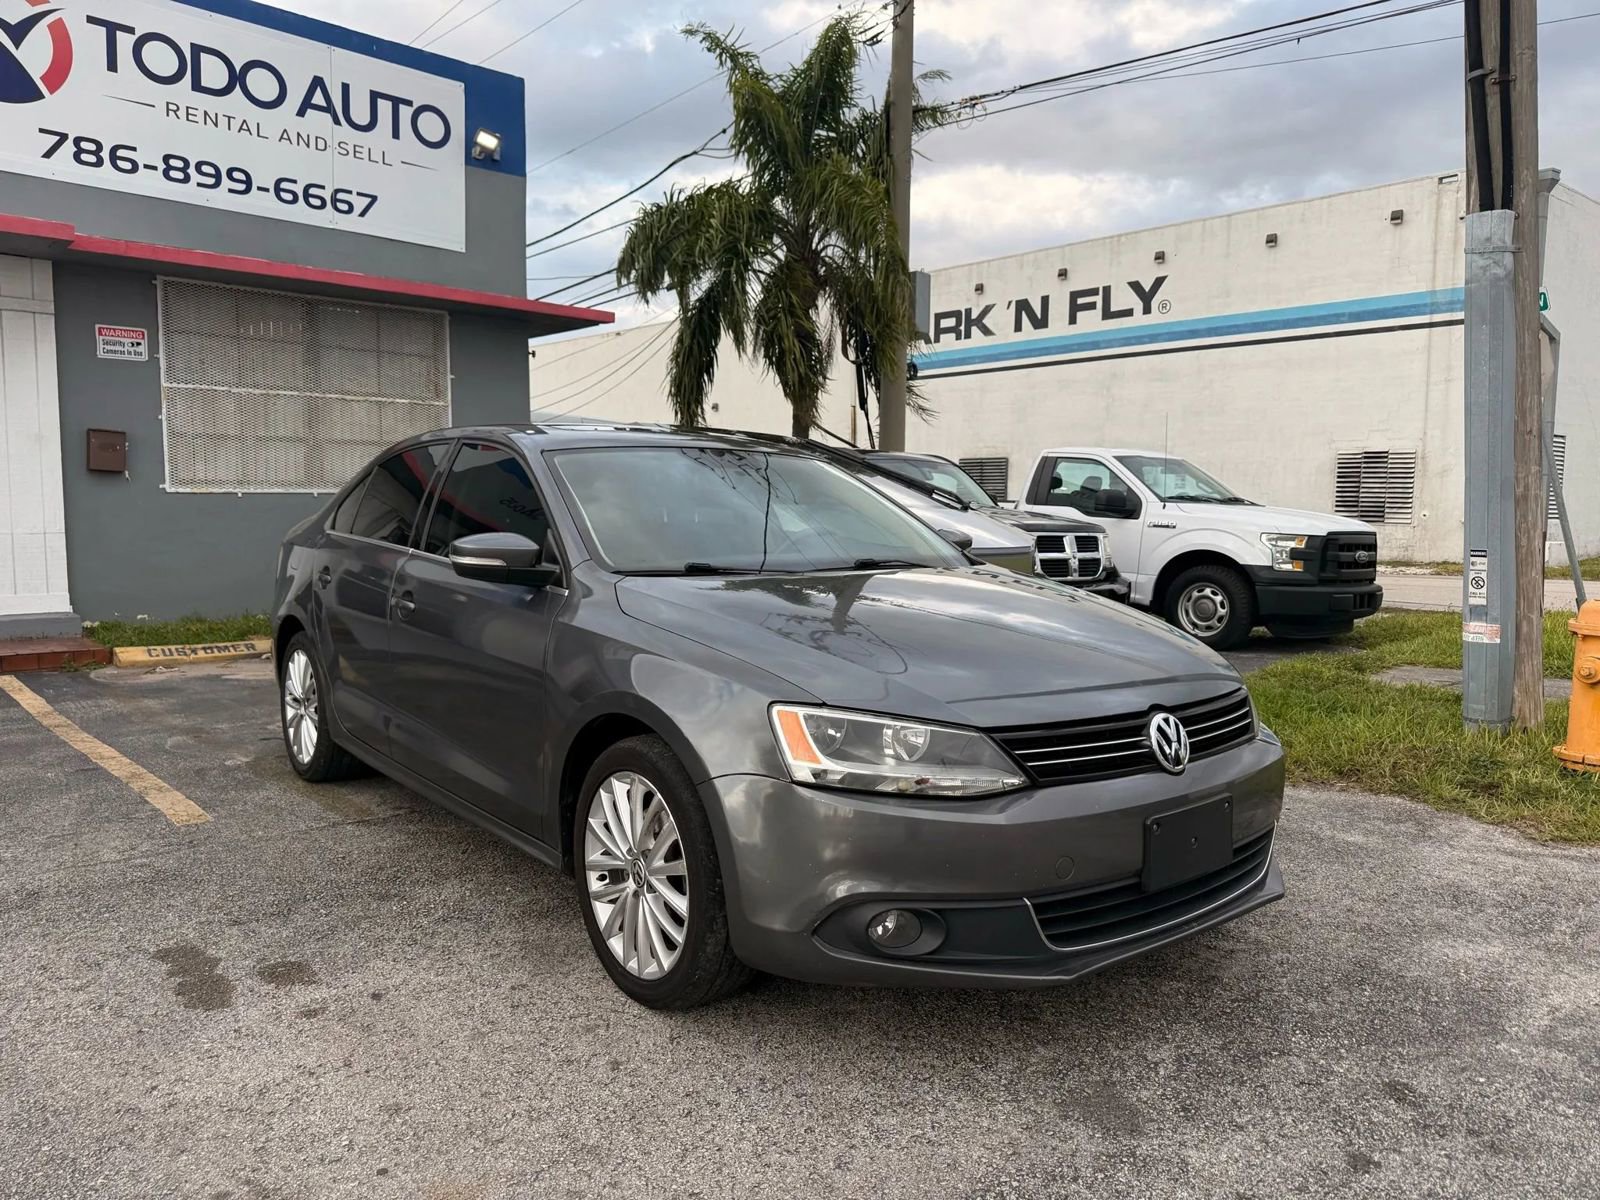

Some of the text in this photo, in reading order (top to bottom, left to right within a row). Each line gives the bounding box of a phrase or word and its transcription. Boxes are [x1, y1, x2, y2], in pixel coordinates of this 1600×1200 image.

[86, 15, 451, 149] TODO AUTO
[165, 101, 393, 166] RENTAL AND SELL
[38, 127, 378, 218] 786-899-6667
[914, 303, 997, 344] RK
[1068, 275, 1169, 325] FLY
[100, 328, 143, 339] WARNING
[102, 339, 125, 348] Security
[102, 347, 126, 355] Cameras
[147, 642, 257, 658] CUSTOMER
